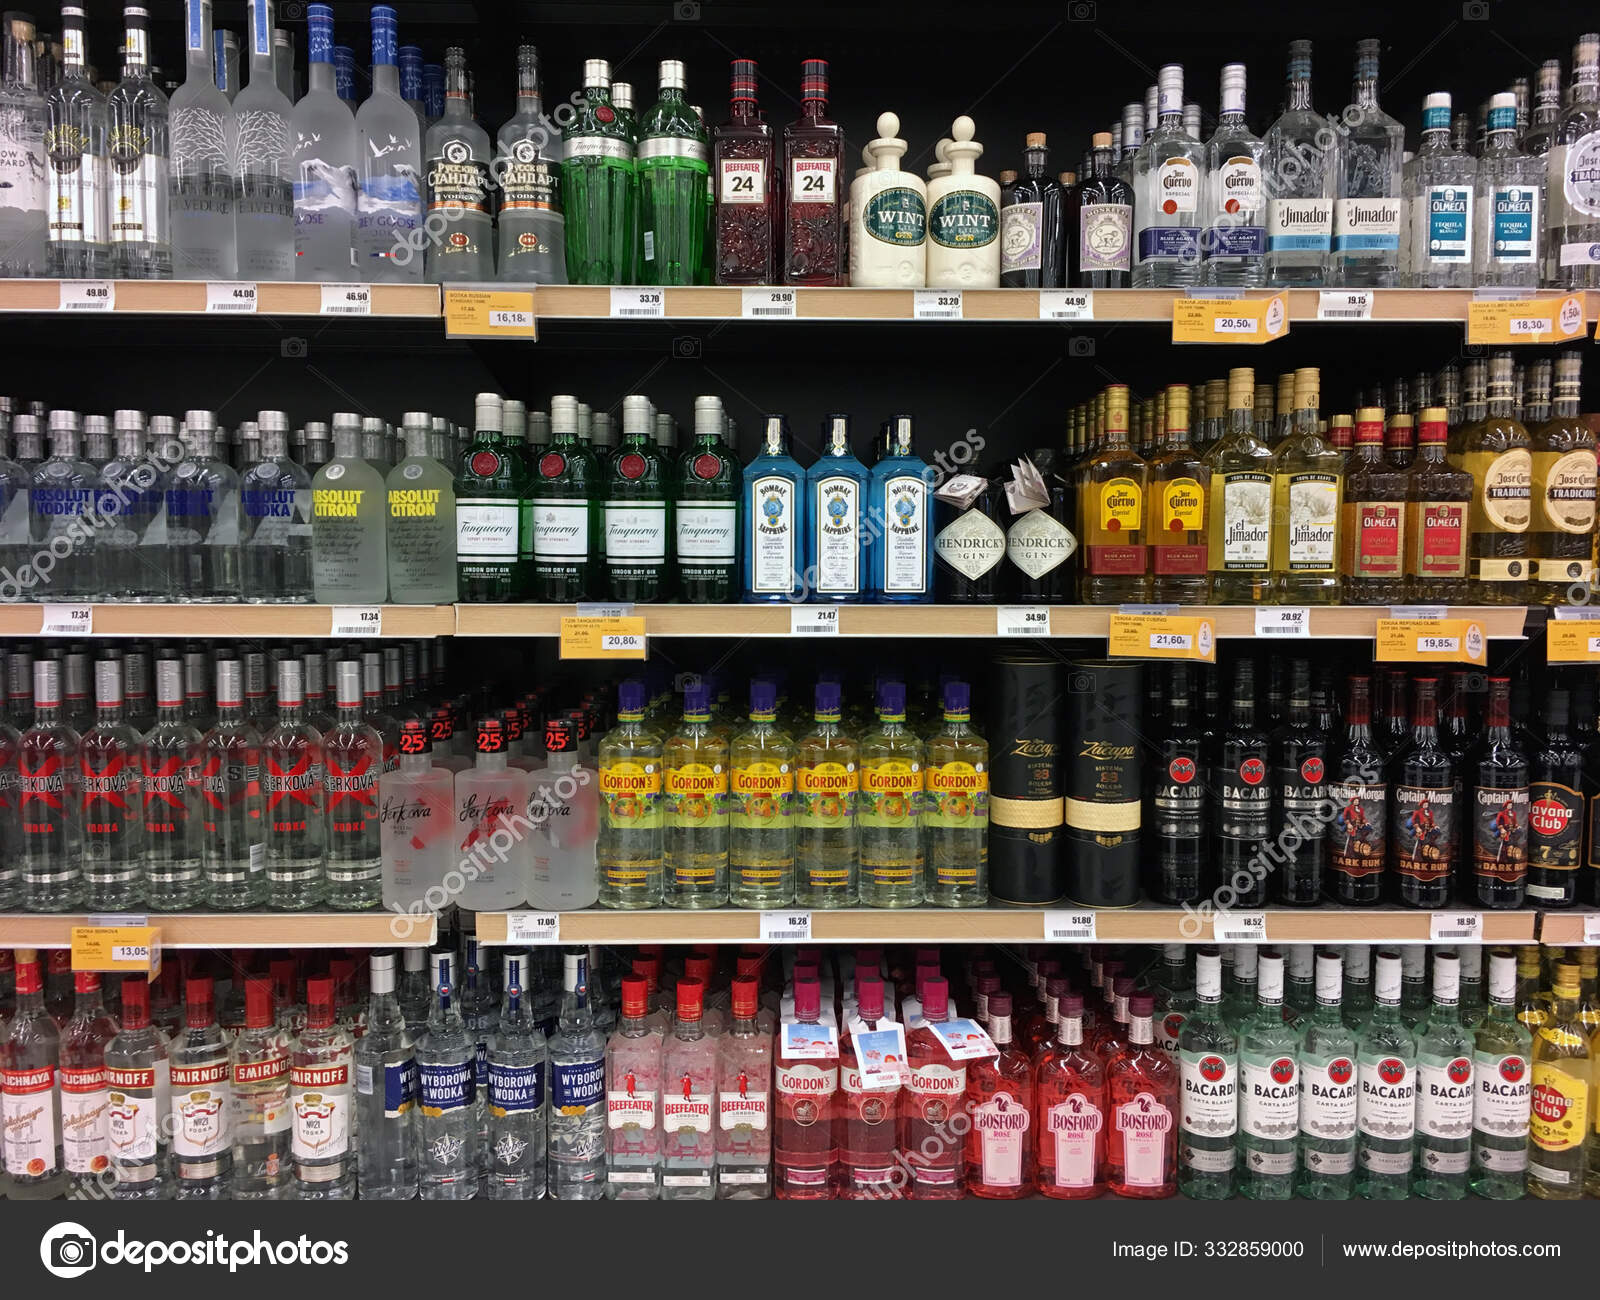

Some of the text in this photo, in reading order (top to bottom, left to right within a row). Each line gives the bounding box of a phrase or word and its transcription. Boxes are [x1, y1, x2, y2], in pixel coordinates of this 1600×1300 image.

[724, 162, 761, 174] BEEFEATER
[795, 162, 832, 174] BEEFEATER
[731, 176, 754, 192] 24
[802, 175, 825, 192] 24
[1163, 175, 1191, 189] Cuervo
[1225, 175, 1254, 189] Cuervo
[1432, 200, 1465, 212] OLMECA
[1497, 200, 1530, 212] OLMECA
[878, 210, 925, 227] WINT
[939, 214, 990, 228] WINT
[1281, 206, 1329, 227] Jimador
[1349, 206, 1398, 227] Jimador
[1434, 221, 1462, 230] TEQUILA
[1500, 222, 1528, 230] TEQUILA
[313, 490, 362, 504] ABSOLUT
[388, 489, 440, 503] ABSOLUT
[1106, 496, 1136, 508] Cuervo
[1169, 496, 1198, 508] Cuervo
[314, 503, 358, 517] CITRON
[391, 503, 436, 517] CITRON
[460, 521, 513, 537] Tanqueray
[1235, 519, 1245, 531] el
[1364, 517, 1397, 528] OLMECA
[1427, 517, 1460, 528] OLMECA
[609, 523, 659, 538] Tanqueray
[680, 523, 729, 538] Tanqueray
[1225, 527, 1268, 546] Jimador
[1290, 527, 1334, 546] Jimador
[963, 552, 986, 560] GIN
[19, 775, 64, 792] ERKOVA
[1223, 786, 1270, 799] BACARD
[1532, 818, 1562, 830] Club
[1400, 861, 1448, 871] DARK RUM
[1483, 861, 1528, 872] DARK RU
[105, 1070, 149, 1085] IRNOFF
[171, 1065, 230, 1083] SMIRNOFF
[420, 1072, 472, 1088] WYBOROWA
[488, 1072, 537, 1088] WYBOROWA
[561, 1067, 604, 1085] WYBOROW
[782, 1074, 830, 1089] GORDON'S
[911, 1074, 960, 1089] GORDON'S
[1482, 1080, 1529, 1097] BACARD
[1254, 1083, 1299, 1098] BACARD
[1312, 1083, 1357, 1098] BACARD
[609, 1100, 653, 1112] BEEFEATER
[665, 1103, 709, 1115] BEEFEATER
[721, 1101, 765, 1113] BEEFEATER
[1534, 1101, 1561, 1119] Club
[979, 1113, 1025, 1130] BOSFORD
[1053, 1113, 1099, 1131] BOSFORD
[1121, 1112, 1168, 1130] BOSFORD
